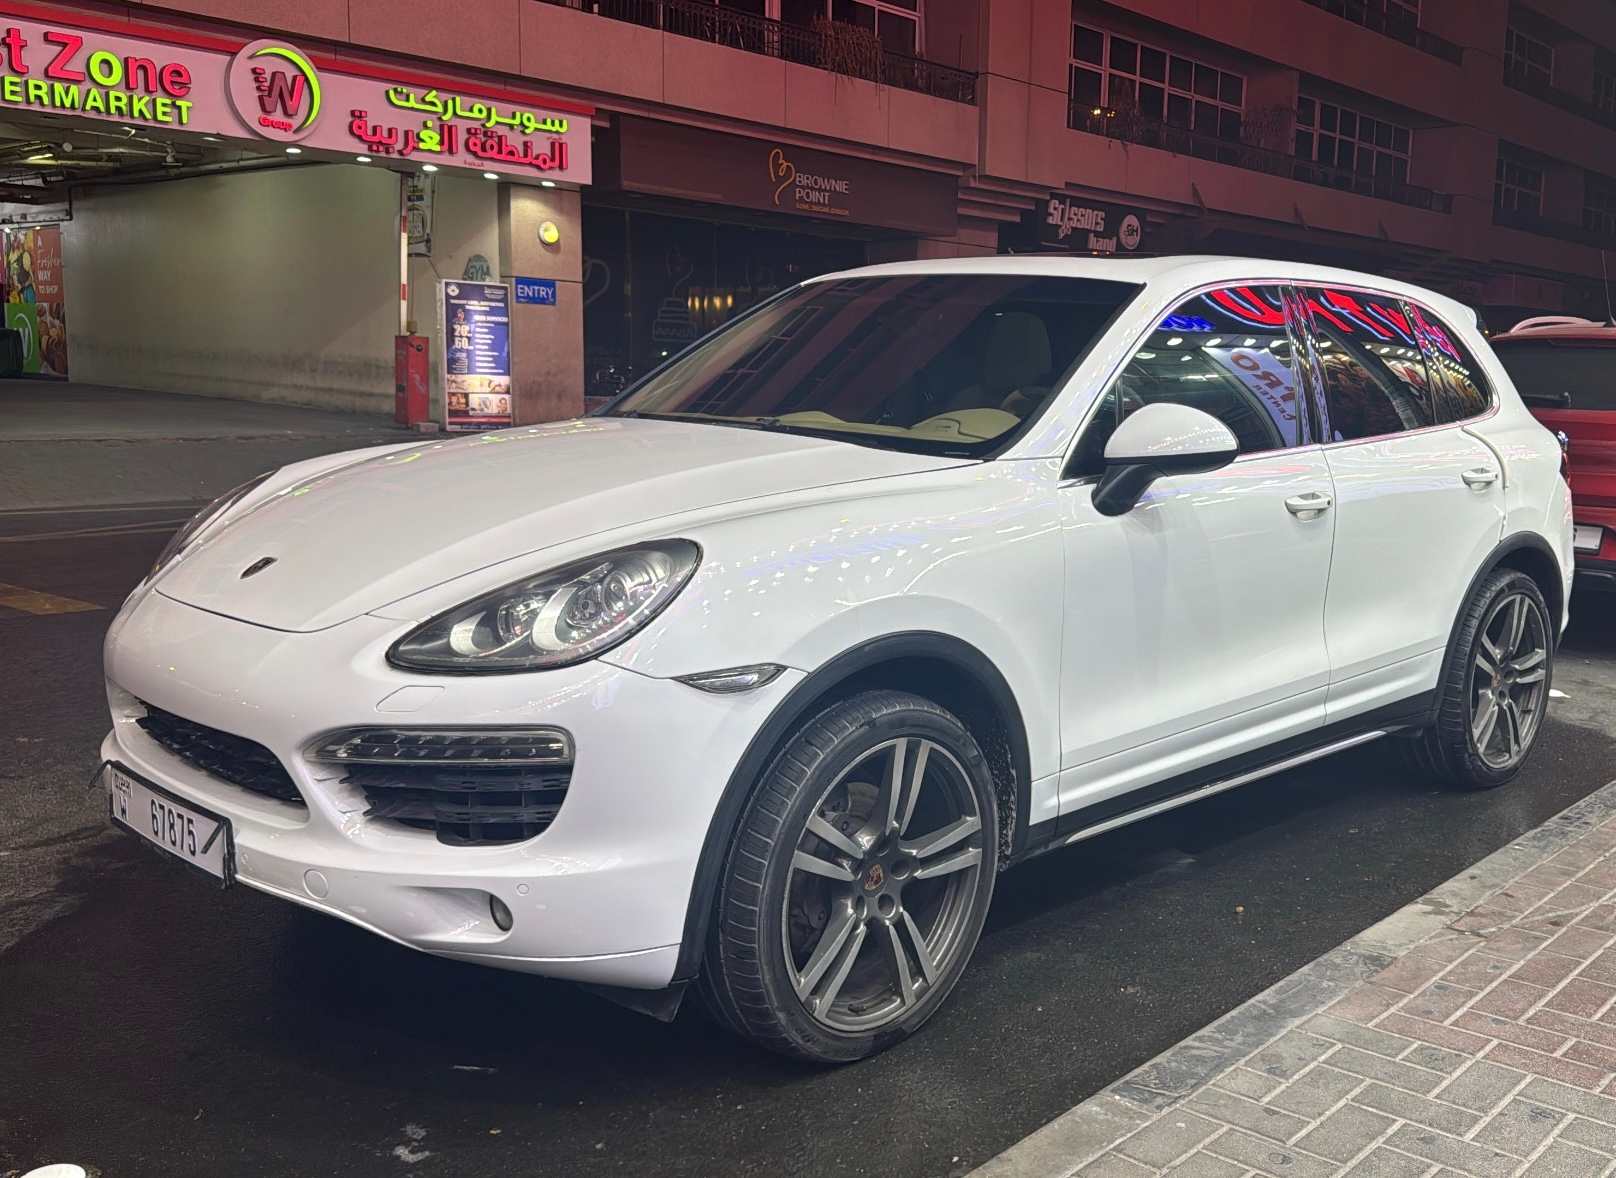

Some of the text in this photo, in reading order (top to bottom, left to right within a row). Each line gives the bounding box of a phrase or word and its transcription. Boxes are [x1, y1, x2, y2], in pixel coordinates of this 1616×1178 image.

[0, 28, 192, 97] t Zone
[1, 75, 192, 125] ERMARKET
[386, 86, 568, 135] سوبرماركت
[258, 115, 293, 132] Group
[349, 109, 568, 170] المنطقة الغربية
[796, 173, 850, 193] BROWNIE
[795, 188, 830, 204] POINT
[37, 235, 43, 247] A
[1087, 232, 1117, 252] hand
[38, 270, 51, 281] WAY
[39, 285, 58, 294] TO SHOP
[517, 284, 555, 299] ENTRY
[151, 798, 197, 856] 67875
